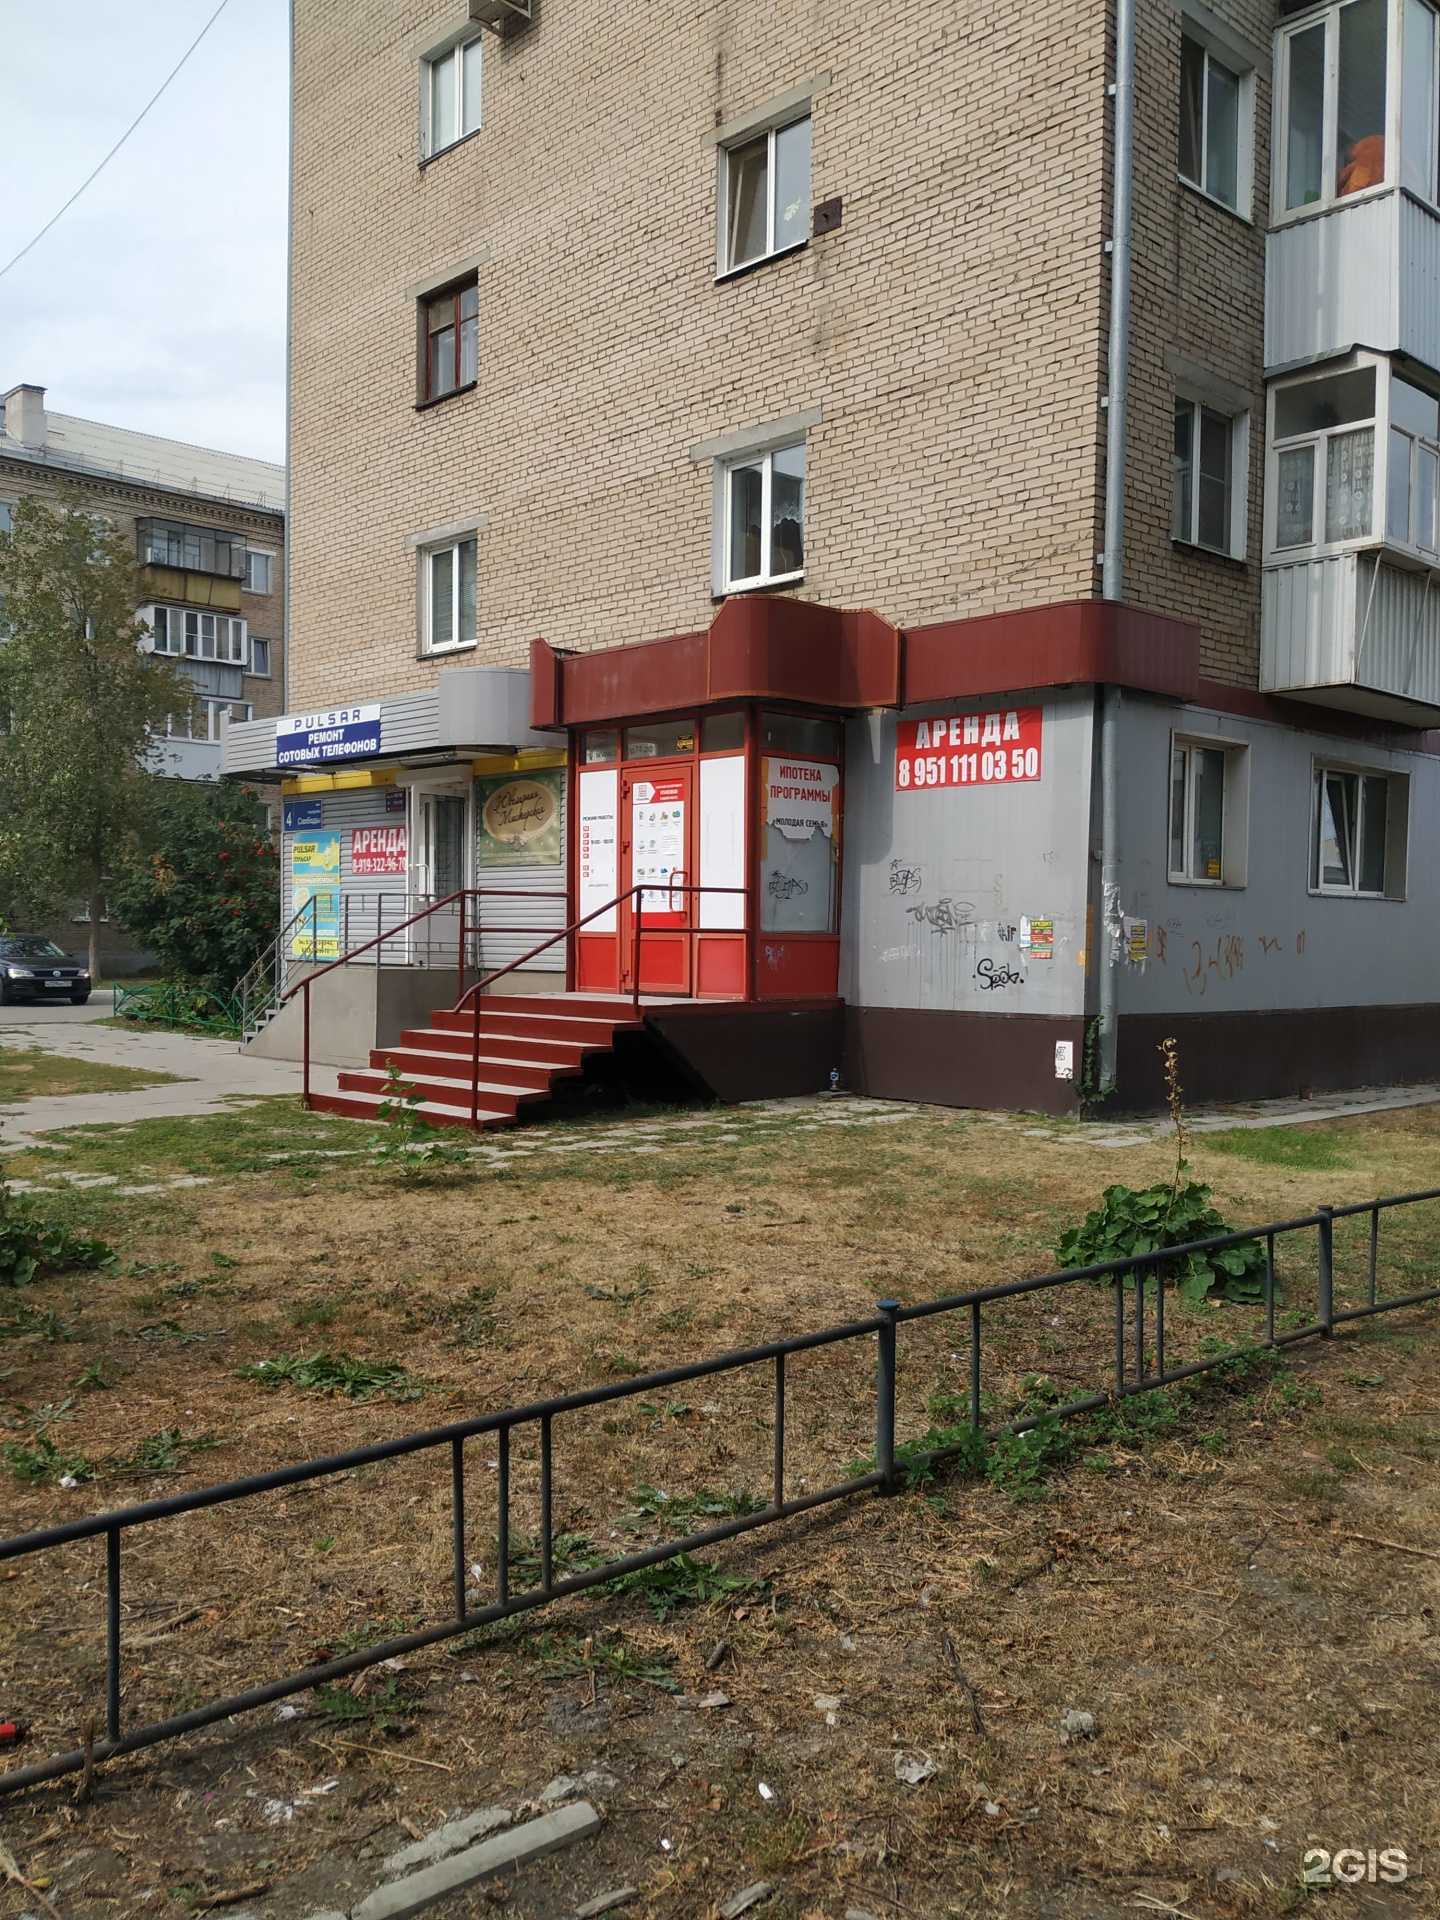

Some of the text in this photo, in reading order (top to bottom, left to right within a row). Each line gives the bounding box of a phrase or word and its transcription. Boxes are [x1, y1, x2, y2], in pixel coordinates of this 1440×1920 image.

[294, 709, 361, 731] PULSAR
[915, 711, 1020, 749] АРЕНДА
[308, 729, 345, 745] РЕМОНТ
[278, 738, 377, 763] СОТОВЫХ ТЕЛЕФОНОВ
[899, 747, 1038, 787] 8 951 111 03 50
[770, 785, 831, 802] ПРОГРАММЫ
[286, 812, 292, 827] 4
[353, 829, 407, 856] АРЕНДА
